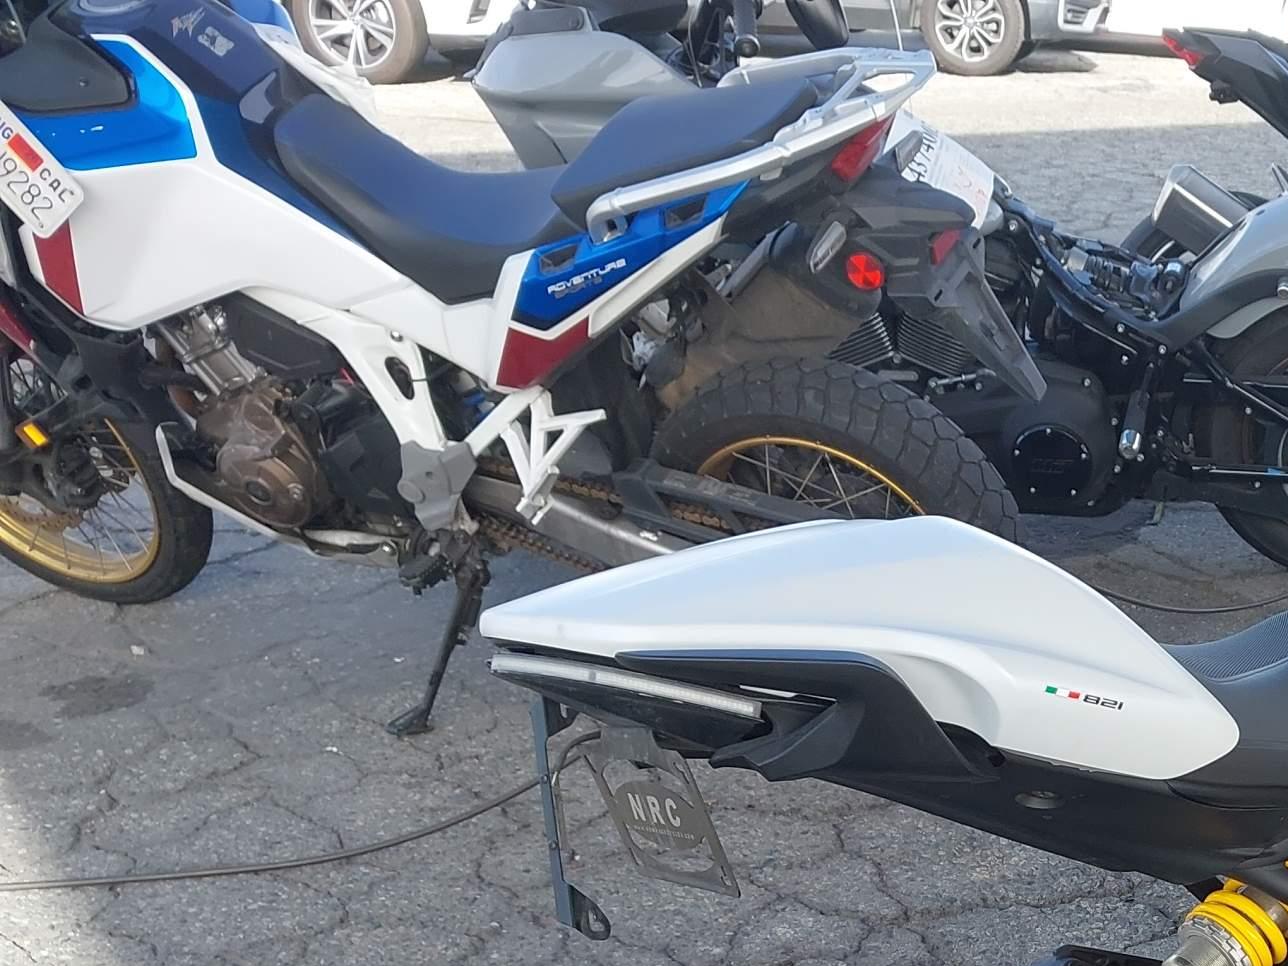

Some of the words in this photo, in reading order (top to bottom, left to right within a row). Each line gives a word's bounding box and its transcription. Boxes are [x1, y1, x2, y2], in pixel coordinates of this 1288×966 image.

[0, 152, 53, 220] 9282
[547, 258, 627, 295] ADVENTURE
[1083, 694, 1124, 711] 821
[627, 792, 681, 828] NRC
